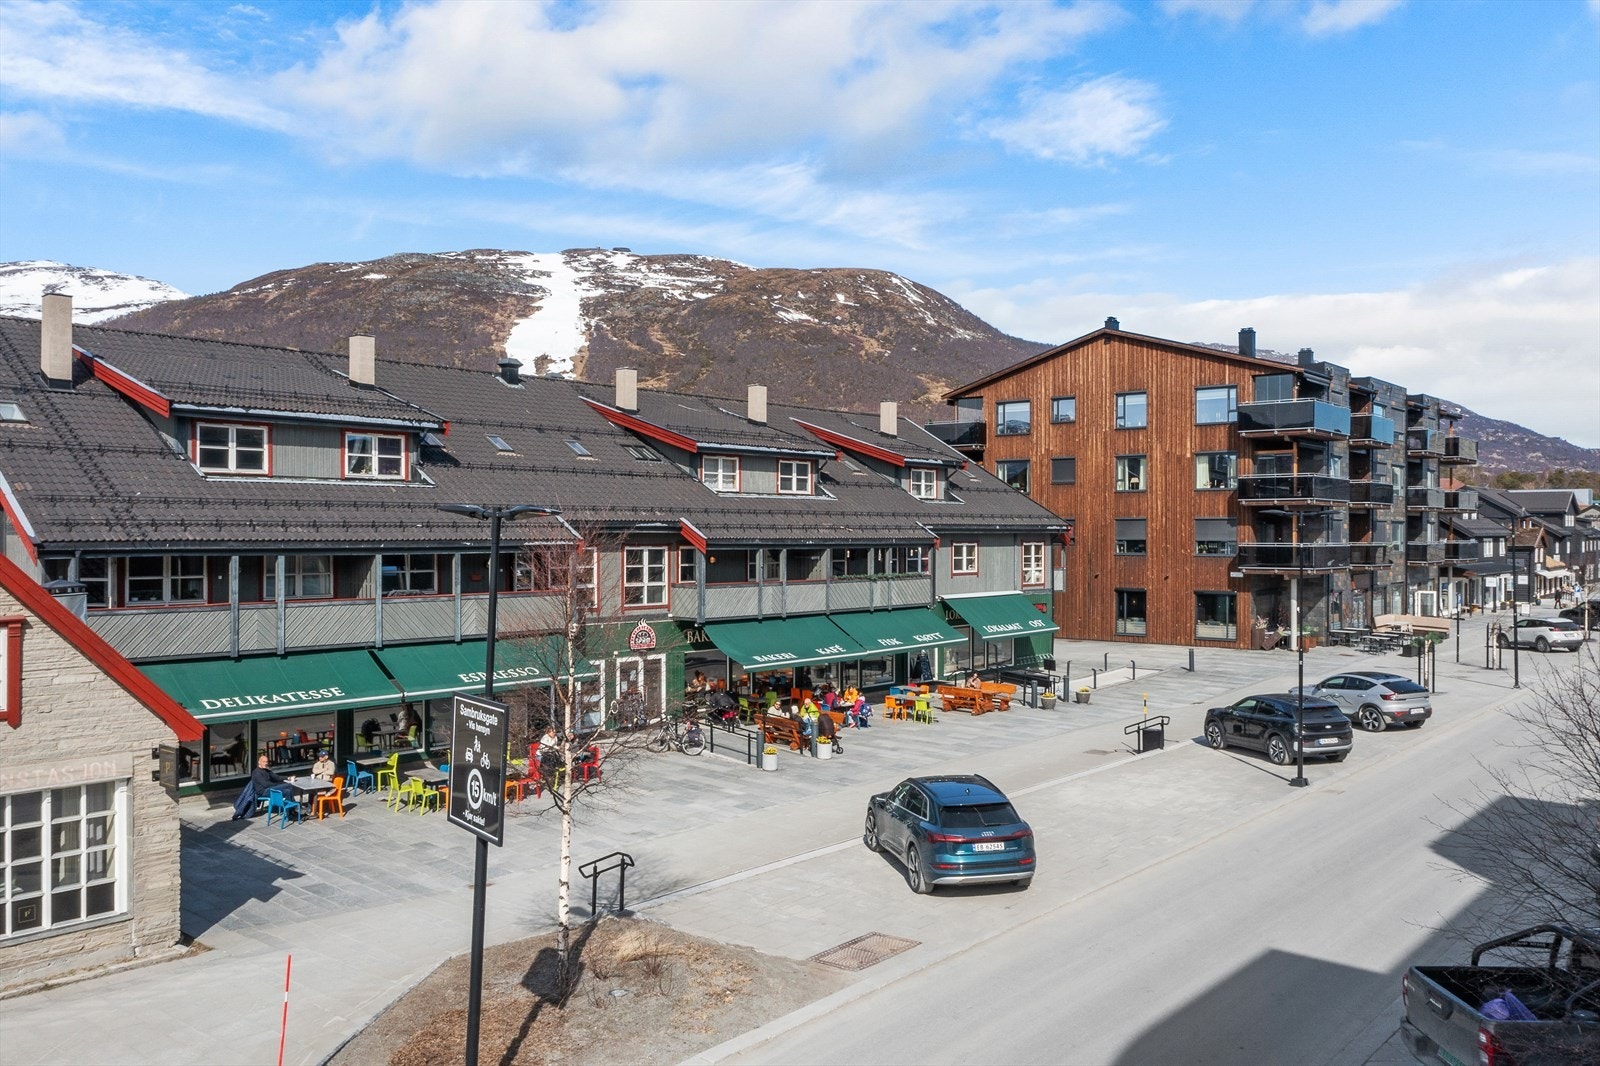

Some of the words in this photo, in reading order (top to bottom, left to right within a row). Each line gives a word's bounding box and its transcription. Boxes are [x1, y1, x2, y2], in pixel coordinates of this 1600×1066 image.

[983, 622, 1024, 633] LOKALMAT
[1029, 619, 1046, 628] OST
[877, 637, 904, 646] FISK
[752, 652, 798, 662] BAKERI
[457, 666, 540, 683] ESPRESSO
[200, 686, 346, 710] DELIKATESSE
[460, 703, 498, 726] Sambruksgate
[471, 780, 480, 798] 15
[483, 787, 497, 807] km/t
